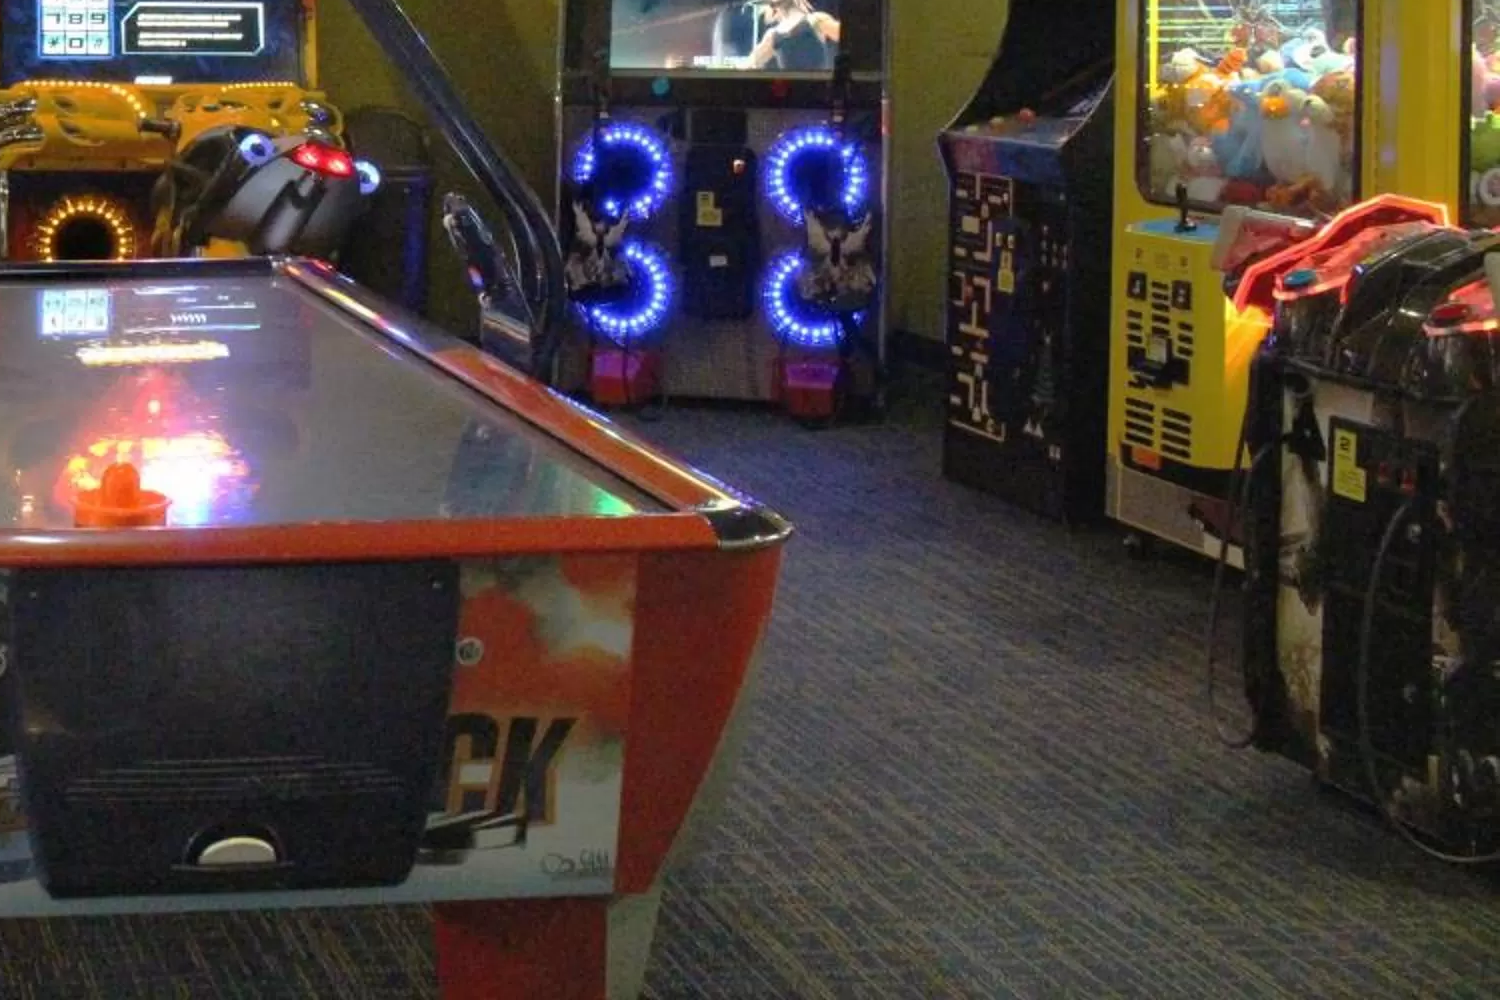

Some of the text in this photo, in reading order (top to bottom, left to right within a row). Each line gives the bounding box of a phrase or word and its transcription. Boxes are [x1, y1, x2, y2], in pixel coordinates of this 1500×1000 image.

[46, 13, 106, 25] 7 8 9
[68, 37, 84, 49] 0
